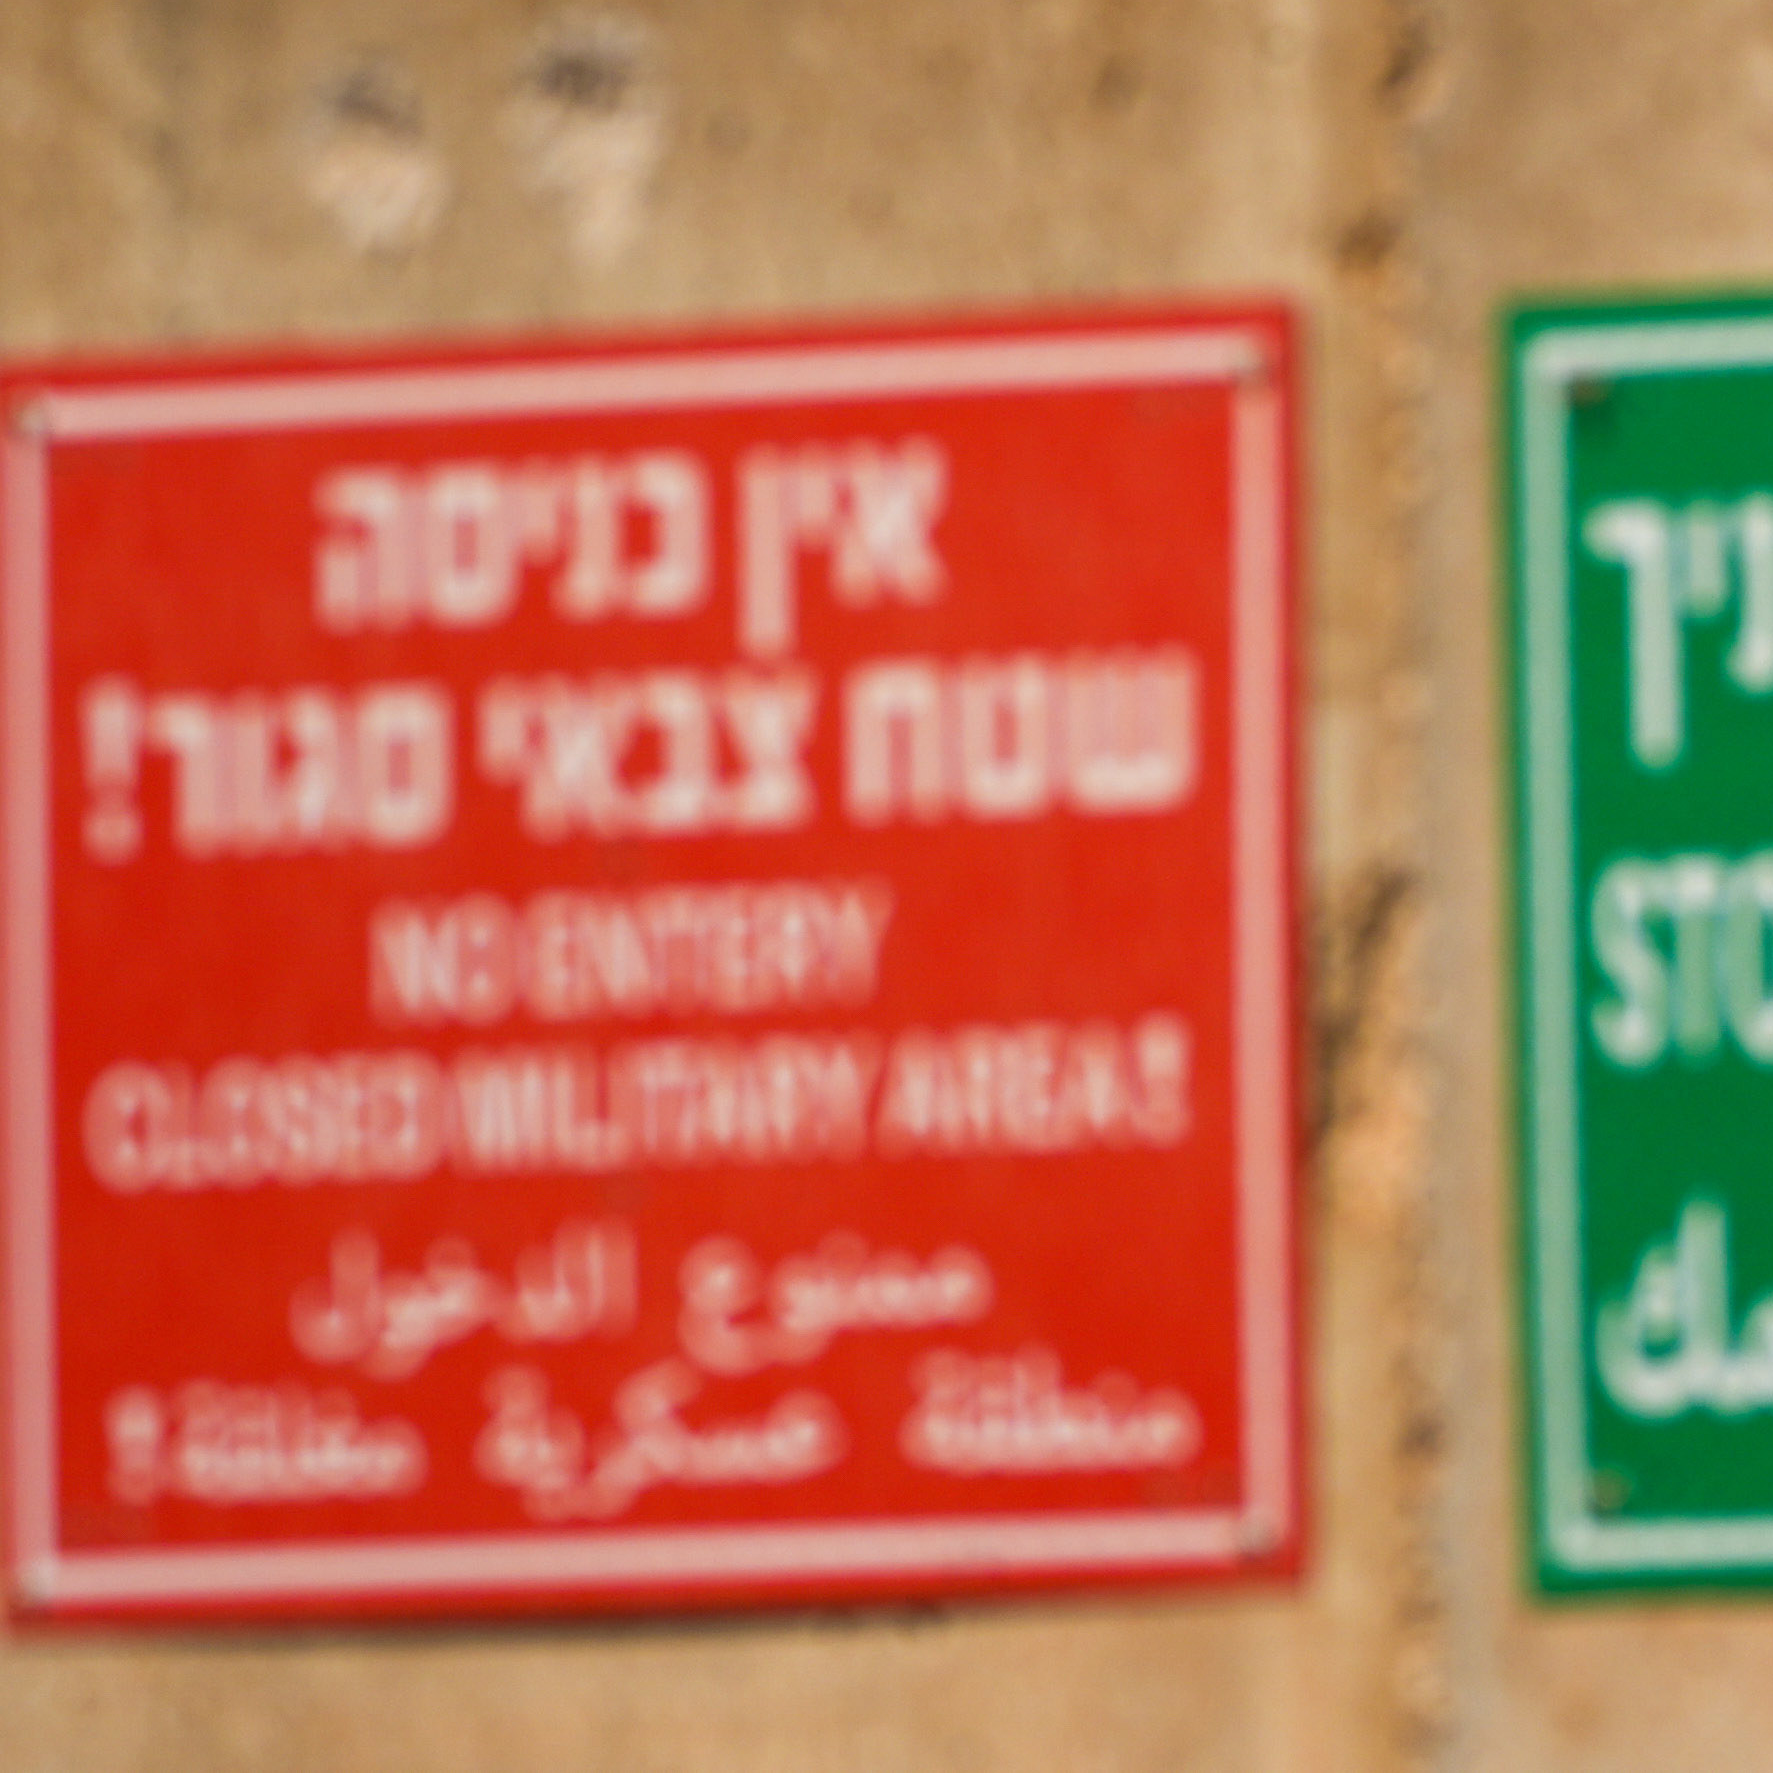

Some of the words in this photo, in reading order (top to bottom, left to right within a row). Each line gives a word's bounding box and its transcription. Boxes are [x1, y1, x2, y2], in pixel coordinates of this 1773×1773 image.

[314, 450, 712, 630] כניסה
[738, 438, 945, 658] אין
[82, 674, 450, 860] סגור!
[478, 664, 818, 838] צבאי
[844, 650, 1198, 816] שטח
[368, 894, 514, 1026] NO
[86, 1052, 440, 1192] CLOSED
[450, 1032, 872, 1172] MILITARY
